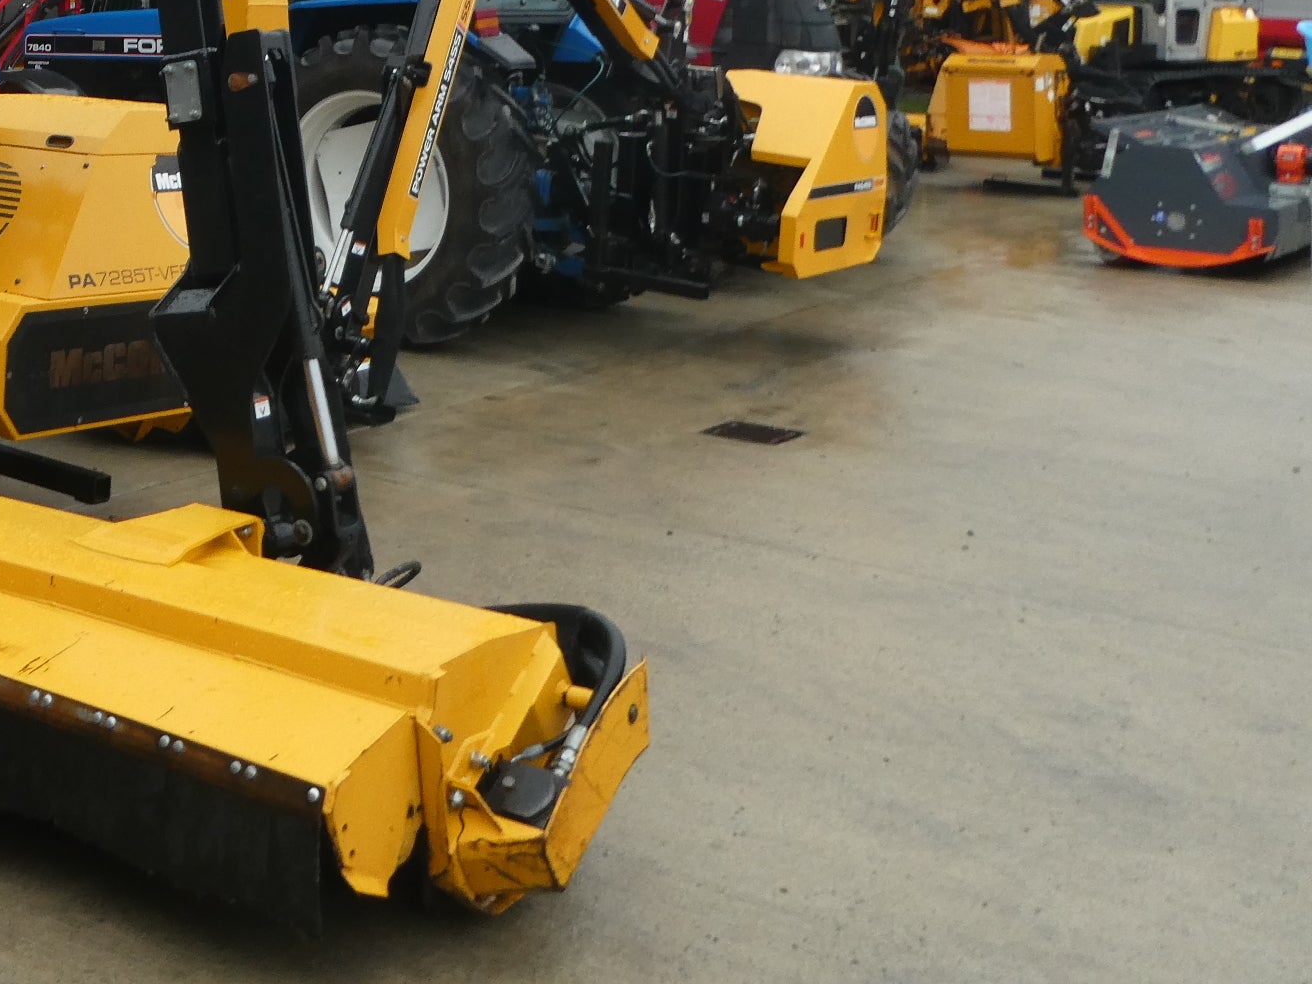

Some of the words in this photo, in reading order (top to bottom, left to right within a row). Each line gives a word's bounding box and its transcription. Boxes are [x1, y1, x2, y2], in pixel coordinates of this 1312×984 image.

[27, 43, 51, 52] 7840
[411, 128, 435, 193] POWER
[431, 86, 448, 126] ARM
